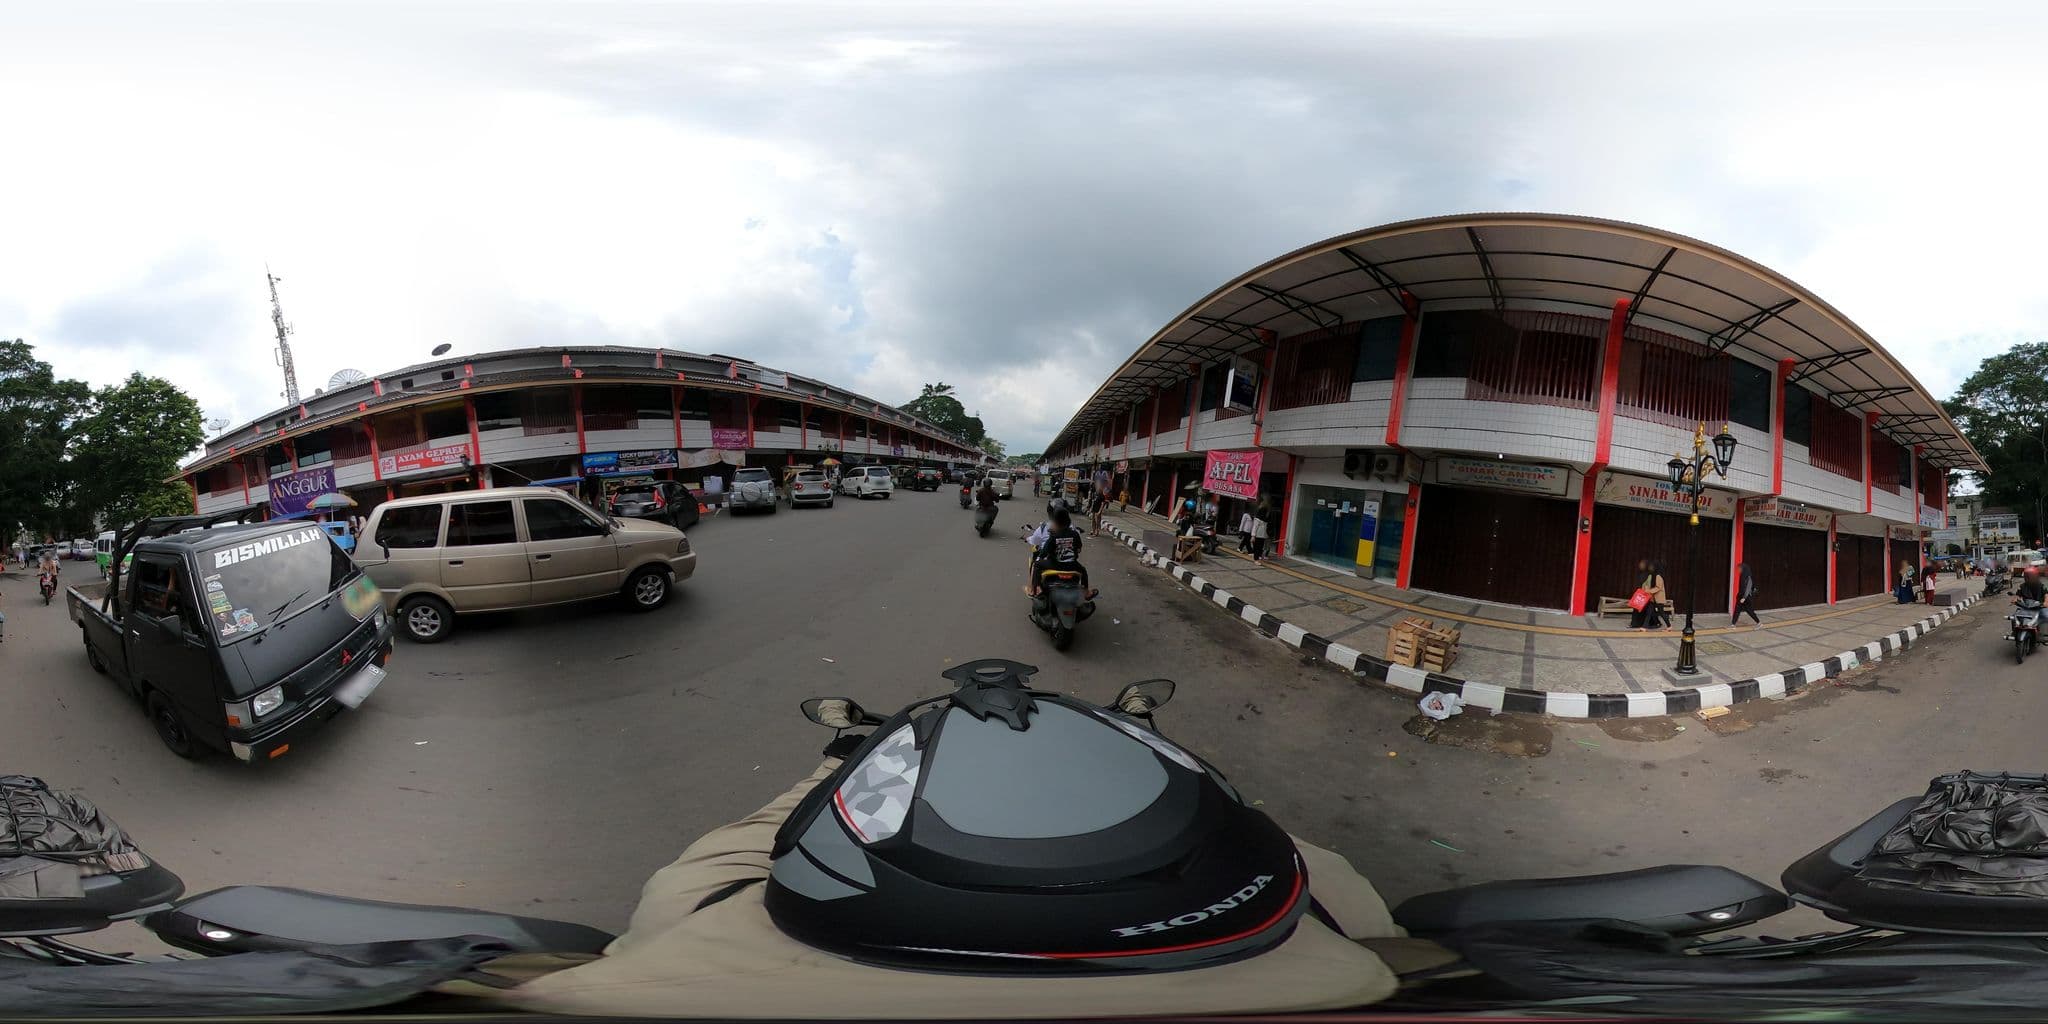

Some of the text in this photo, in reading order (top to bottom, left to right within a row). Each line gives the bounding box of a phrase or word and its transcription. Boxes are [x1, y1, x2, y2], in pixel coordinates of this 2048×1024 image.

[398, 446, 465, 463] AYAM GEPREK
[1210, 461, 1252, 484] APEL
[272, 474, 330, 498] ANGGUR
[1628, 485, 1669, 501] SINAR
[1672, 489, 1713, 507] ABDI
[1794, 511, 1817, 524] ABADI
[213, 529, 321, 568] BISMILLAH
[1110, 874, 1274, 938] HONDA
